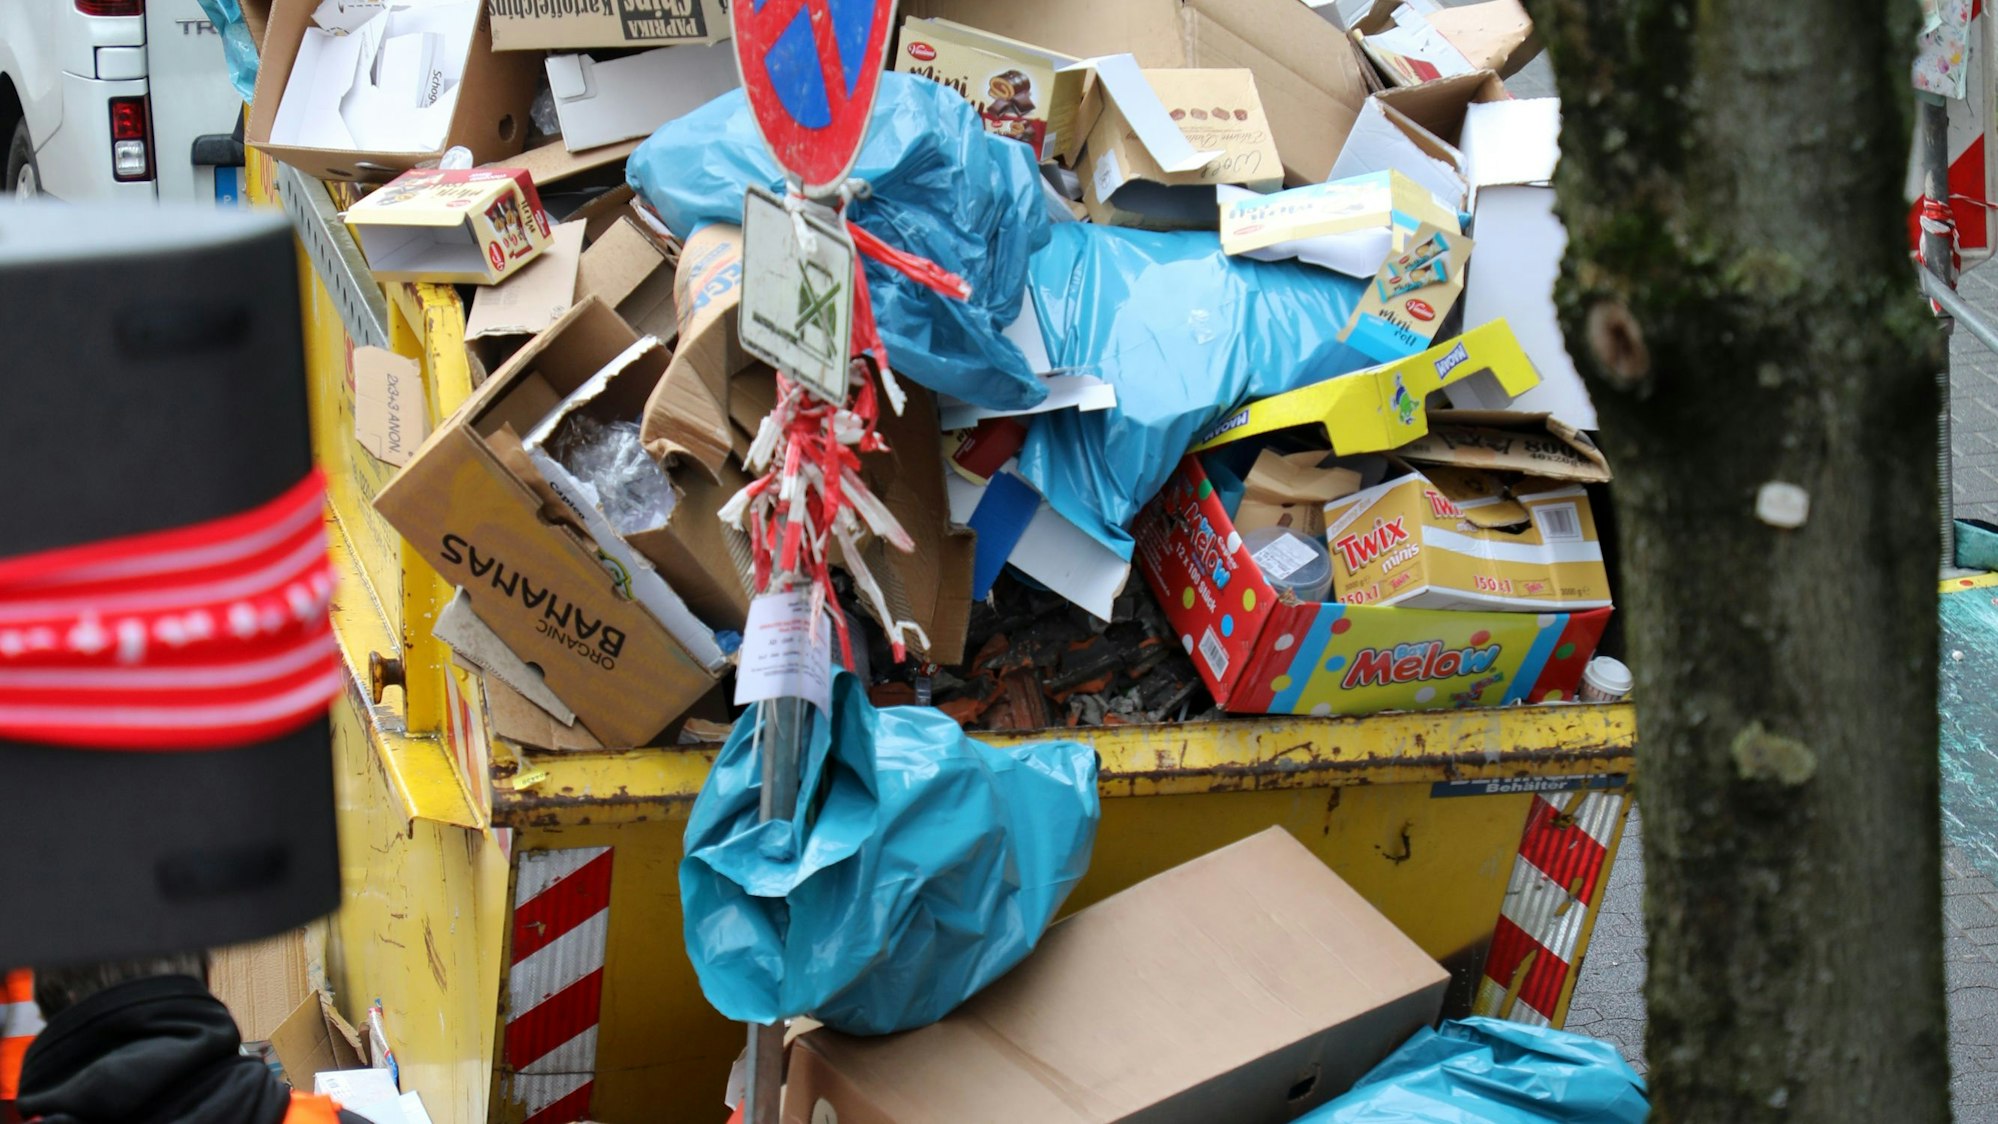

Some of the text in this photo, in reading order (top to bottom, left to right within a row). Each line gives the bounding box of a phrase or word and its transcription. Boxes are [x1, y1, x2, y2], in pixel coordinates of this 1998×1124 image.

[628, 18, 698, 38] PAPRIKA
[1394, 330, 1417, 347] roll
[1336, 516, 1408, 571] Twix
[1382, 543, 1420, 574] minis
[441, 533, 626, 658] BANANAS
[536, 619, 615, 670] ORGANIC
[1341, 640, 1502, 689] Melow
[1485, 780, 1568, 793] Behälter
